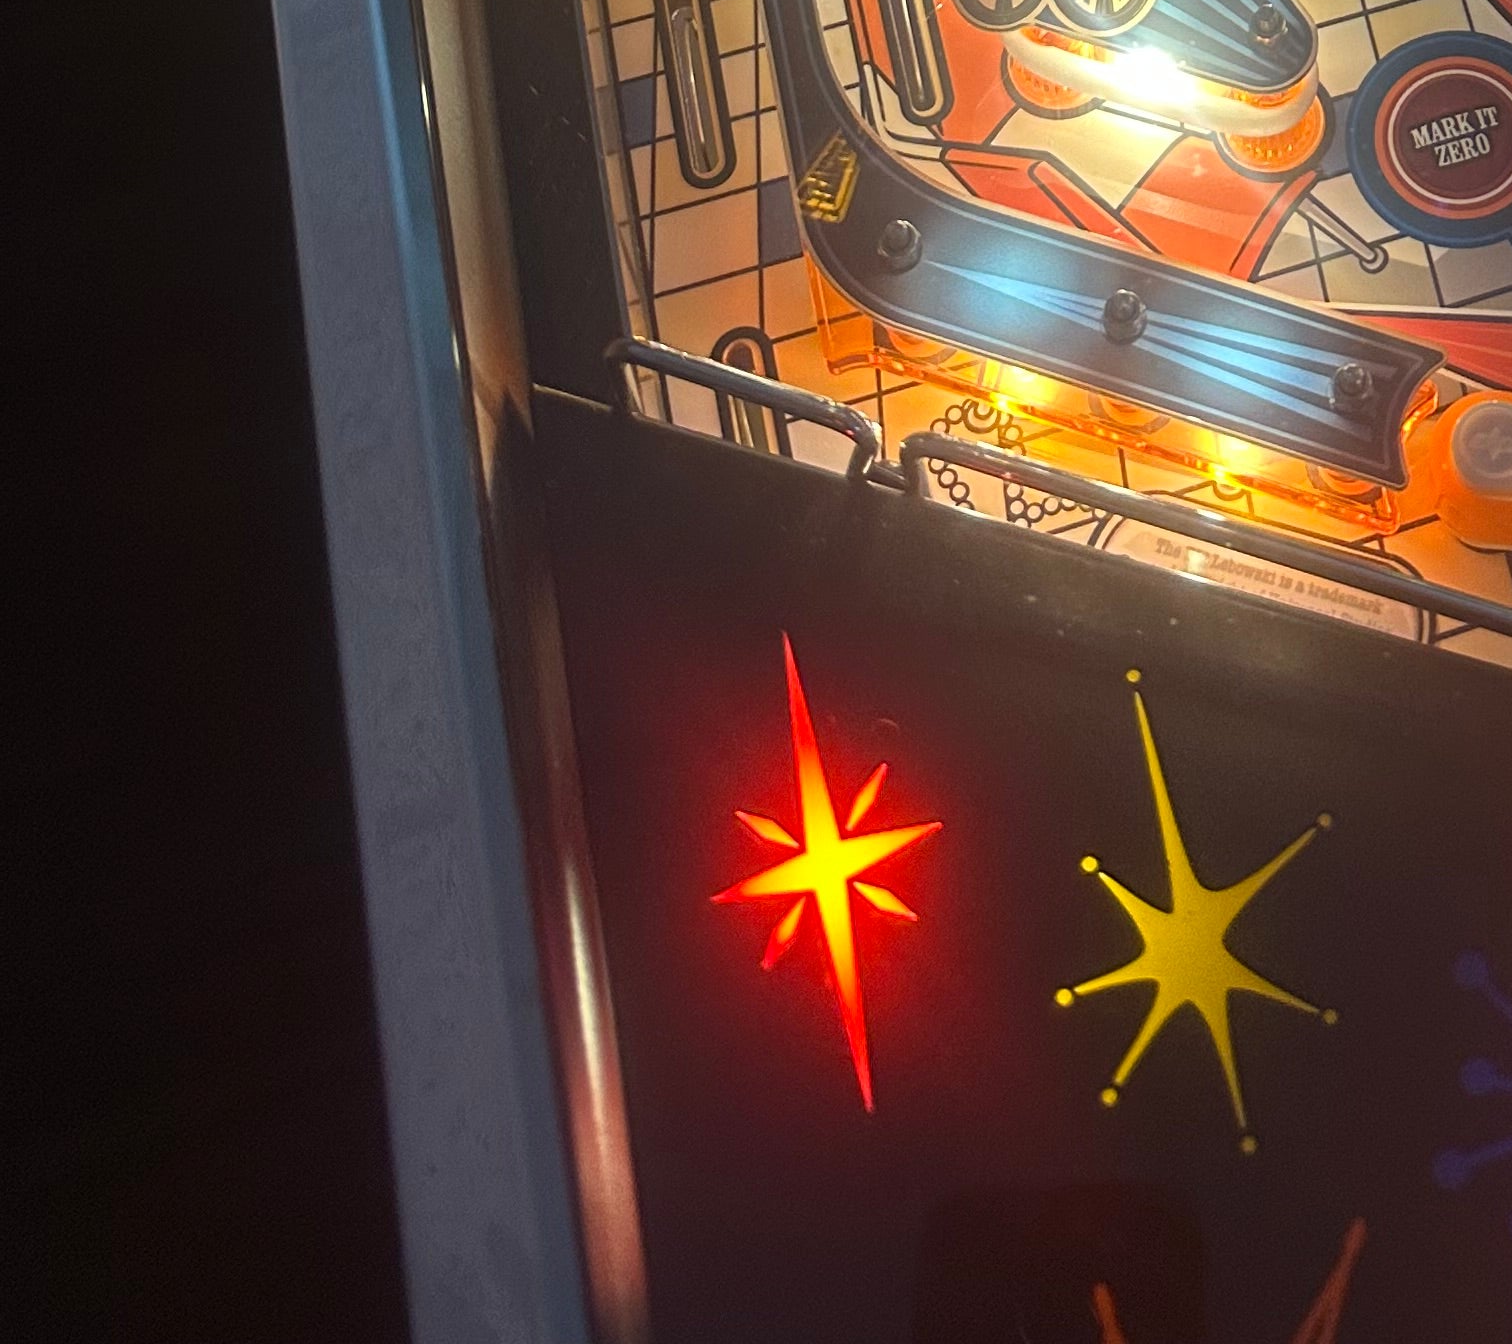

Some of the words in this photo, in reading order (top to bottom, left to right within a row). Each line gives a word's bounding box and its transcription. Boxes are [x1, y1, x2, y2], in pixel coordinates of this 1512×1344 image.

[1410, 112, 1476, 149] MARK
[1475, 106, 1500, 131] IT
[1434, 133, 1491, 167] ZERO
